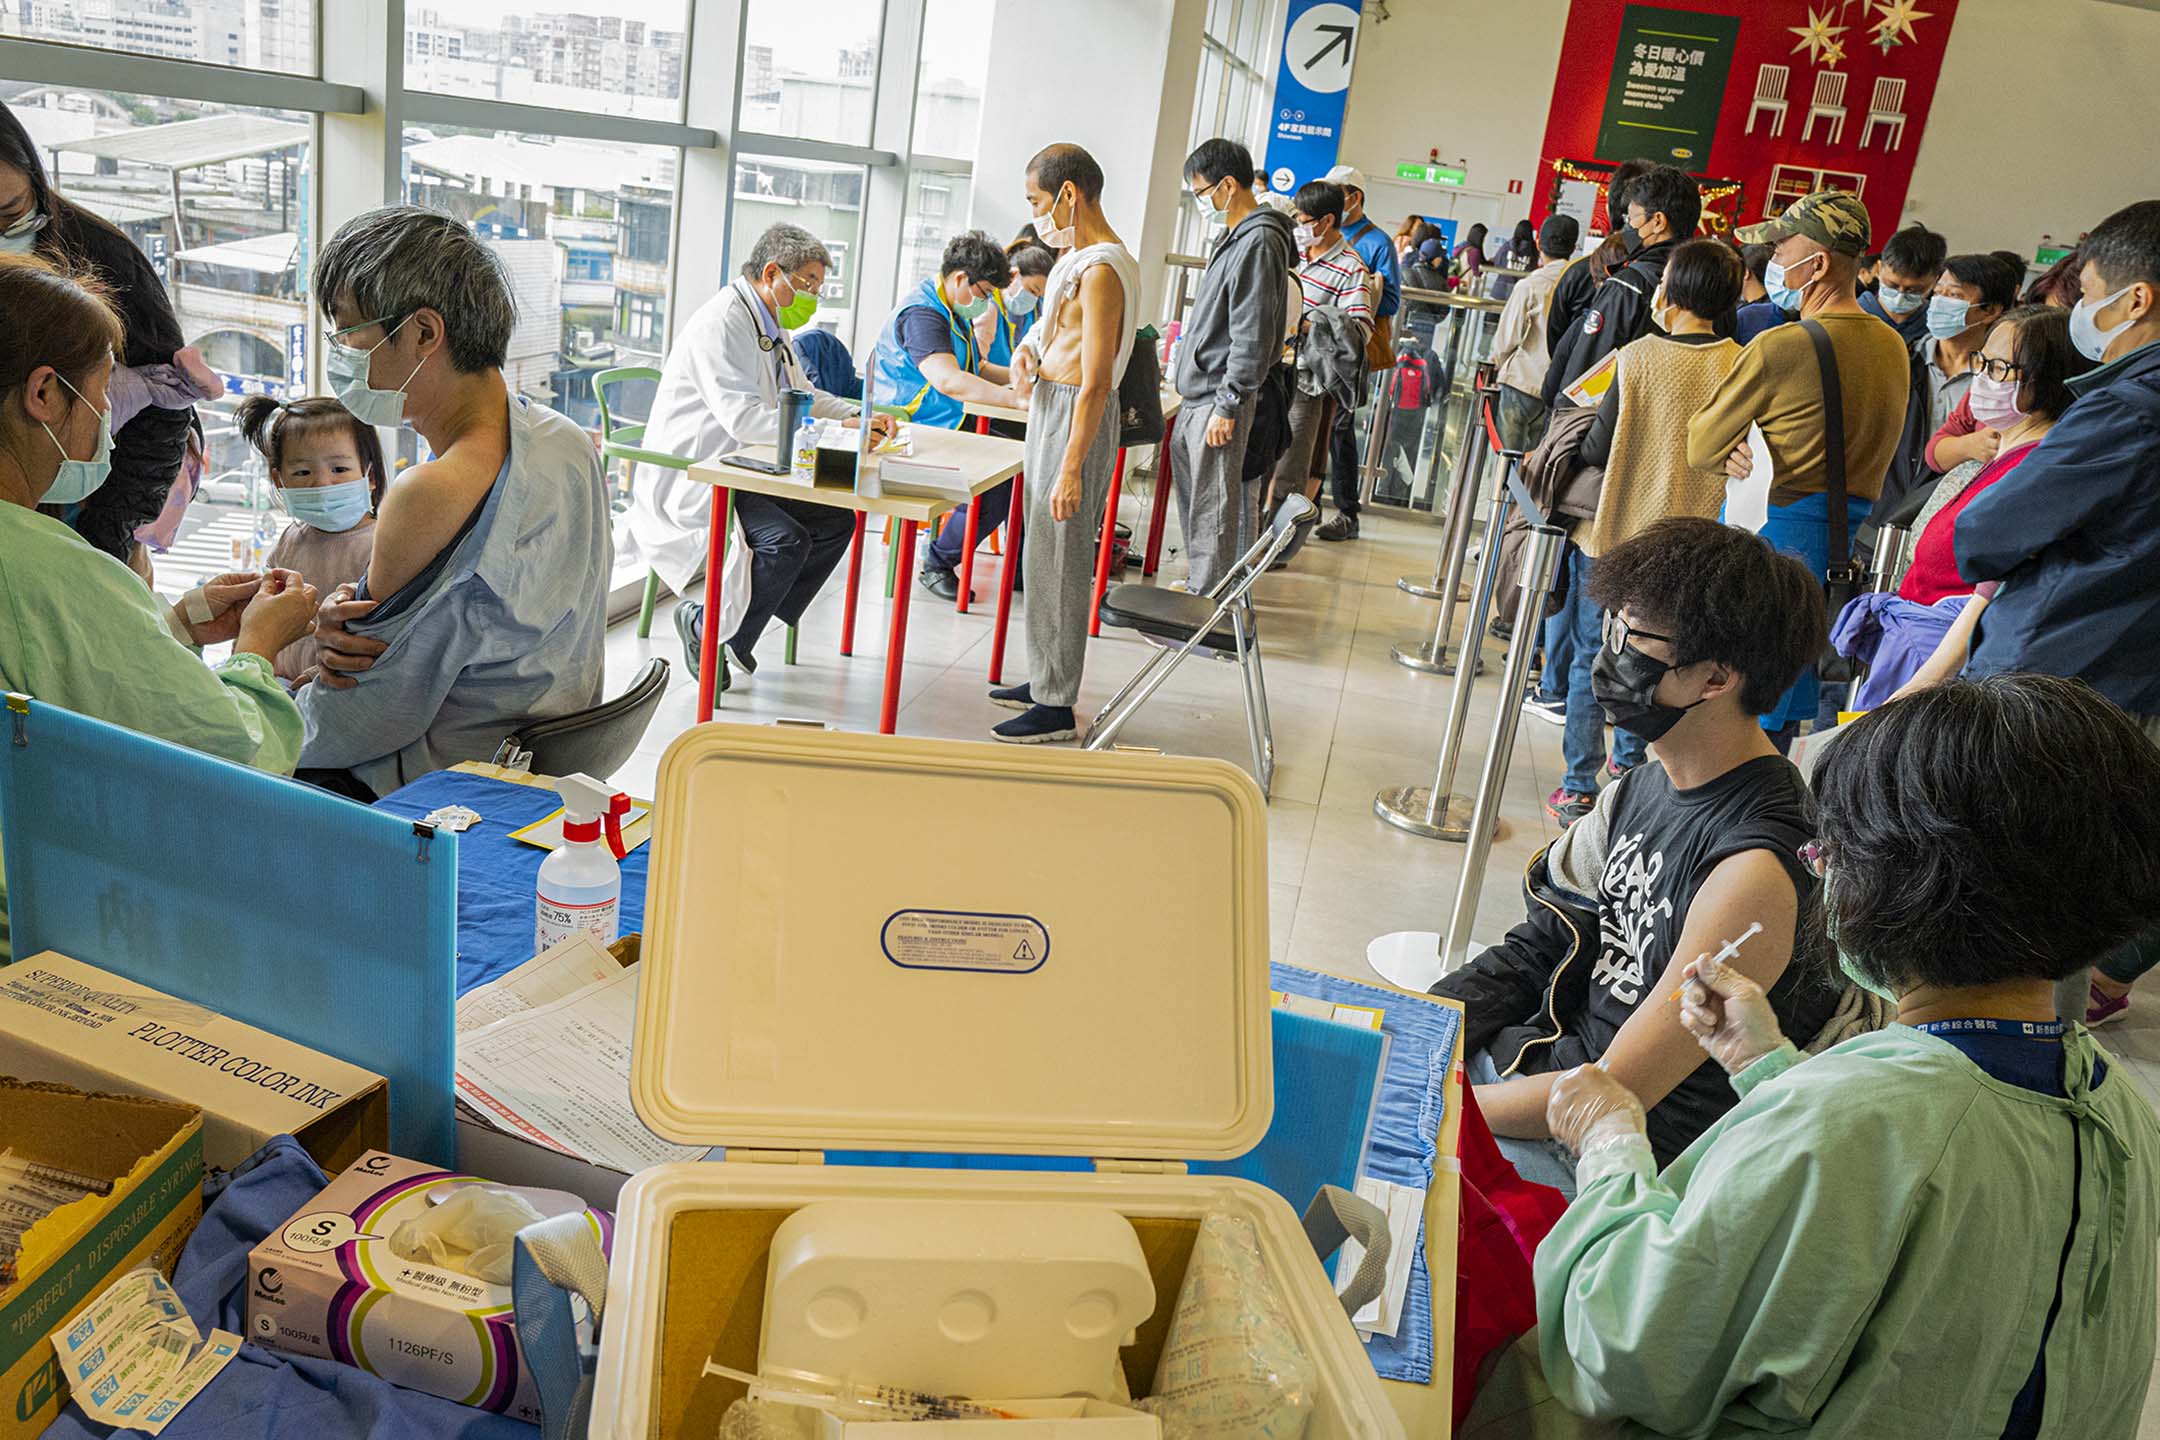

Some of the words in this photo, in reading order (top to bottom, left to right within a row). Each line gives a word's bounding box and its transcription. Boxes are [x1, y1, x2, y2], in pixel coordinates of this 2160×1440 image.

[1633, 42, 1705, 67] 冬日暖心價
[1628, 60, 1687, 82] 為愛加溫
[553, 910, 571, 924] 75%
[25, 969, 91, 997] SUPERIOR
[128, 1022, 230, 1067] PLOTTER
[219, 1055, 299, 1095] COLOR
[288, 1082, 344, 1109] INK
[87, 1191, 157, 1273] DISPOSABLE
[160, 1149, 202, 1199] SYRINGE
[311, 1221, 336, 1235] S
[260, 1319, 270, 1331] S
[388, 1337, 455, 1365] 1126PF/S
